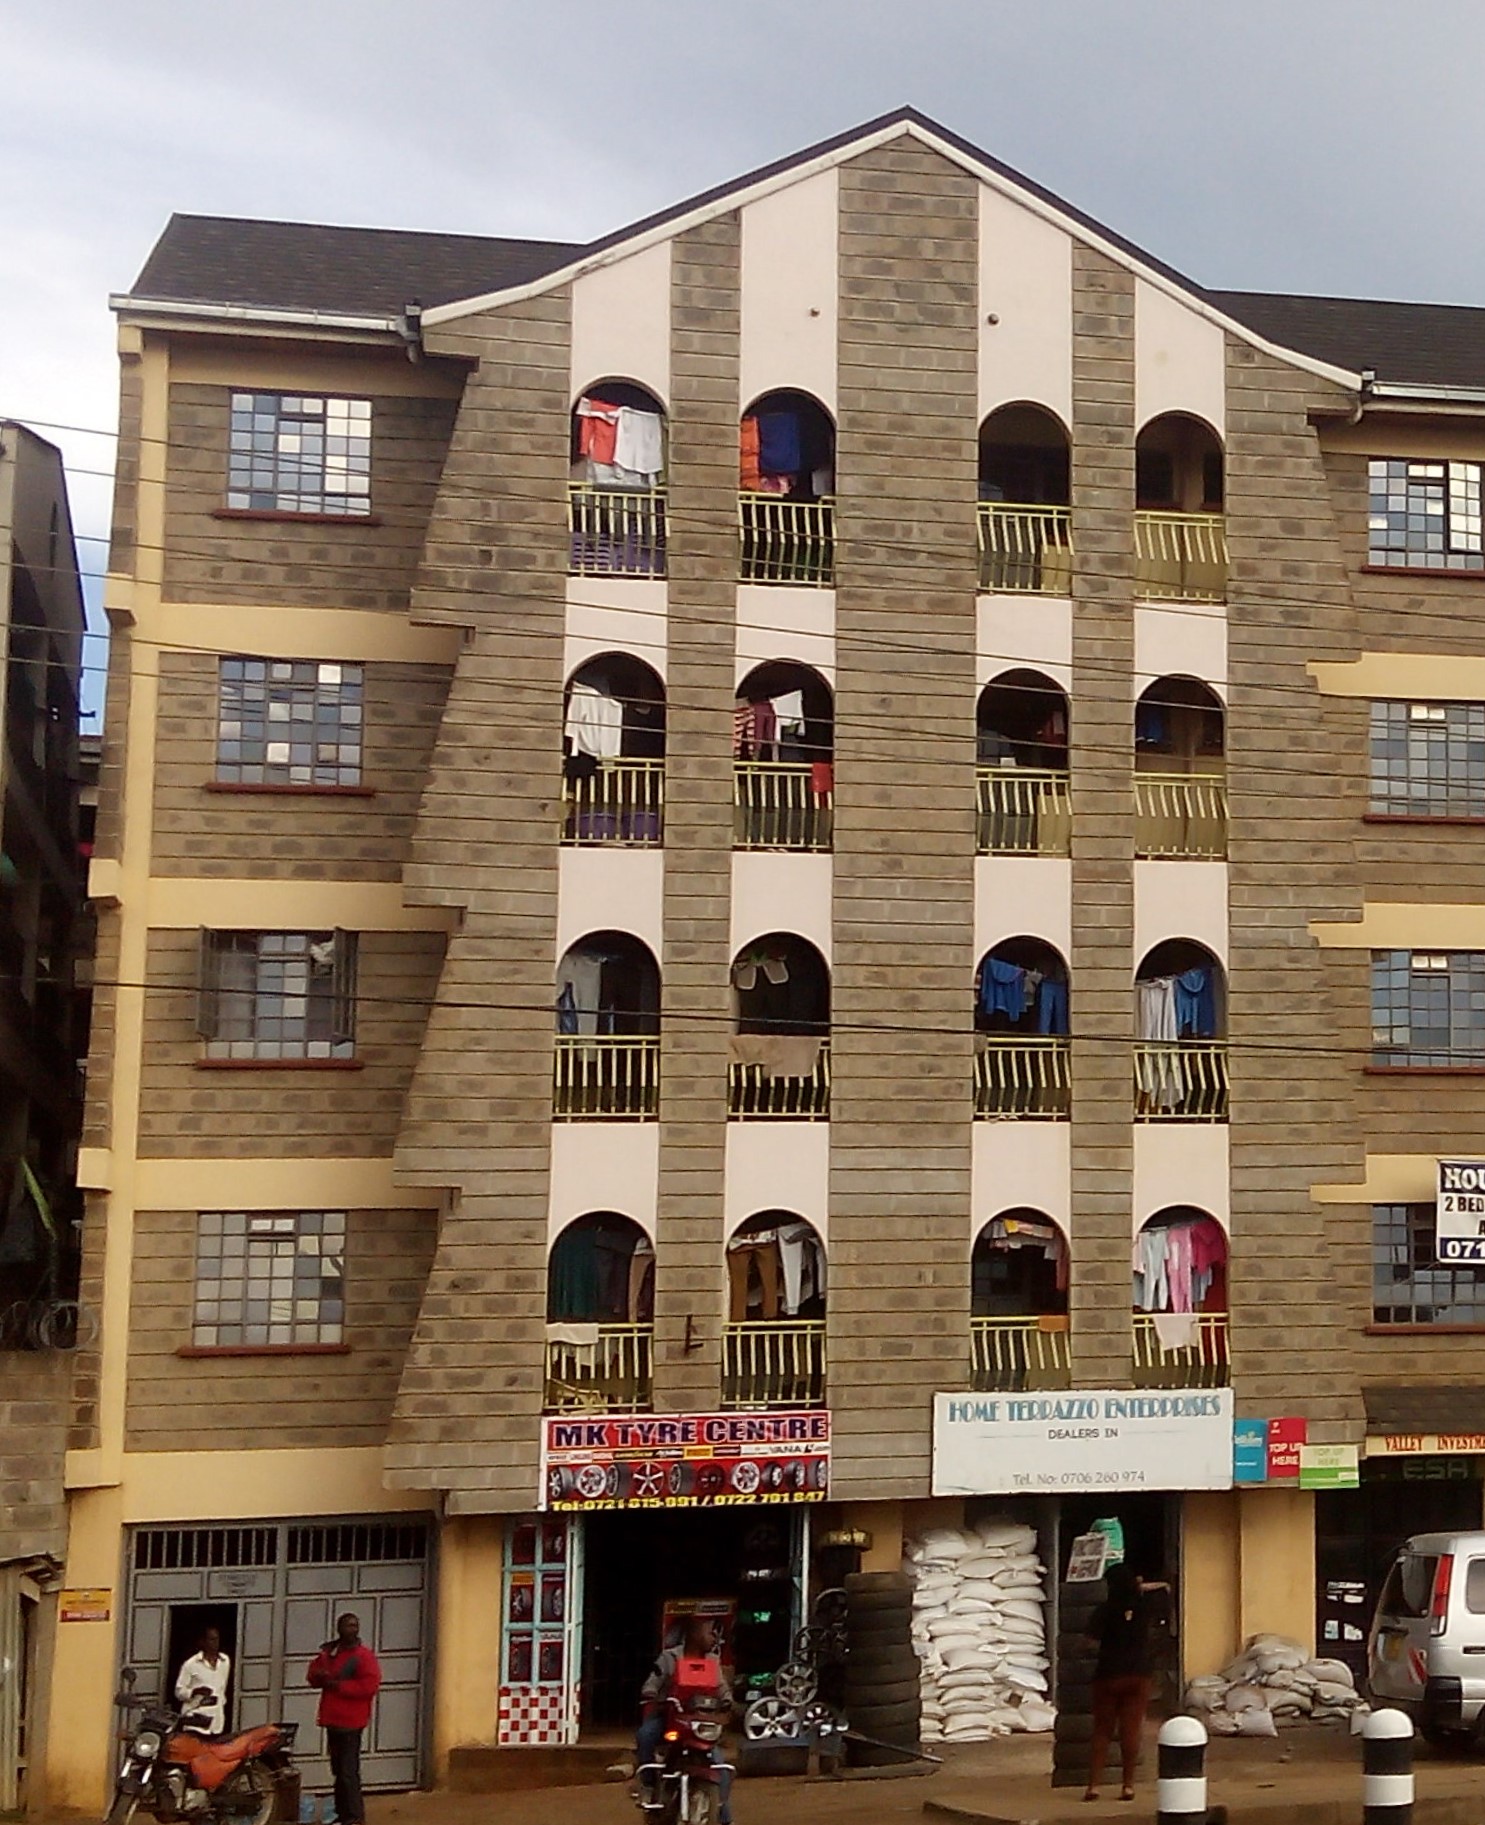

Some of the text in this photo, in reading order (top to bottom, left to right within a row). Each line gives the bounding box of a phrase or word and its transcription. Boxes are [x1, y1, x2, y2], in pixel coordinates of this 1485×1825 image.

[1445, 1196, 1454, 1212] 2
[949, 1395, 1220, 1422] HOME TERRAZZO ENTERPRISES
[553, 1416, 827, 1448] MK TYRE CENTRE
[1048, 1428, 1119, 1440] DEALERS IN
[1269, 1443, 1286, 1453] TOP
[1385, 1436, 1424, 1451] VALLEY
[1272, 1455, 1300, 1466] HERE
[1013, 1473, 1031, 1485] Tel.
[1061, 1472, 1093, 1484] 0706
[1122, 1470, 1145, 1483] 974
[713, 1493, 757, 1506] 0722
